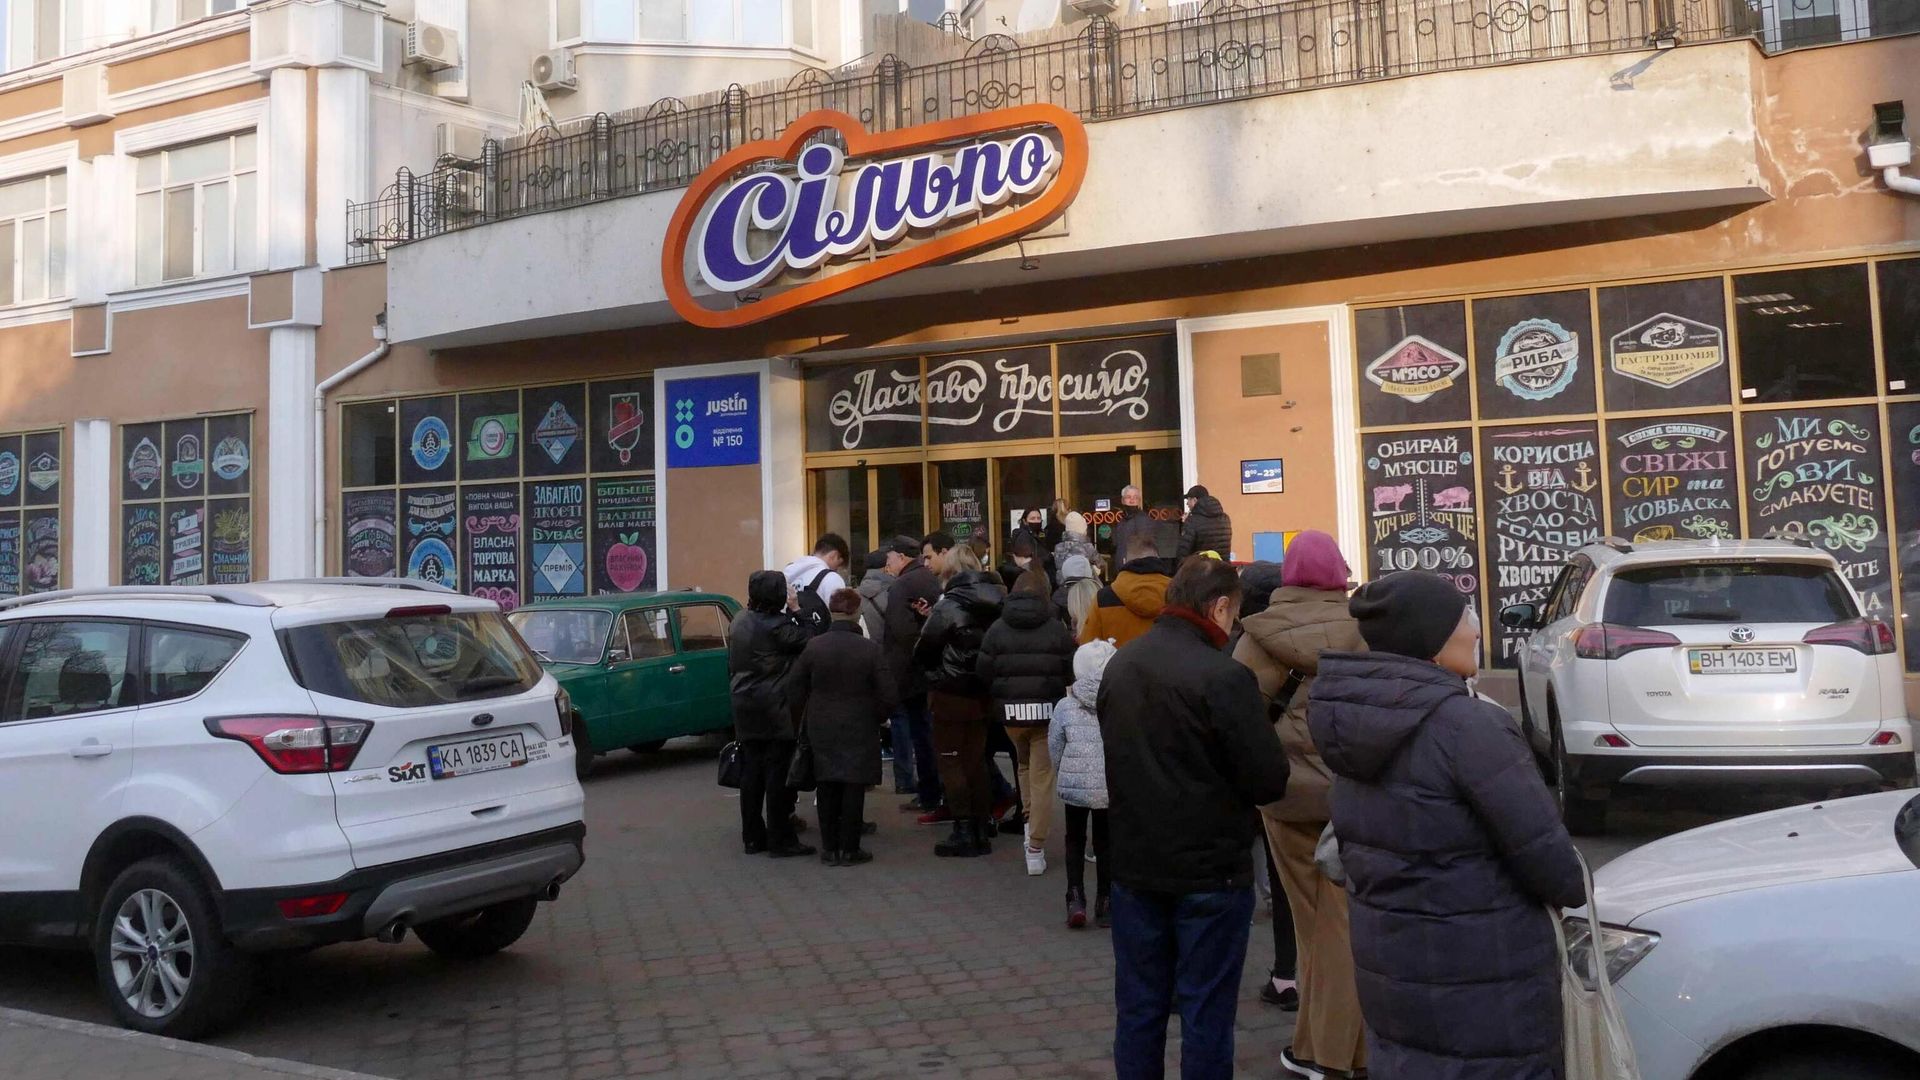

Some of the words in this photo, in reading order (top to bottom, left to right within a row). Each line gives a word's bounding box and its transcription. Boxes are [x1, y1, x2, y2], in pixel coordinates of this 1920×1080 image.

[700, 133, 1060, 291] Сільпо
[1512, 348, 1563, 369] РИБА
[1620, 350, 1714, 365] ГАСТРОНОМІЯ
[1392, 365, 1441, 382] М'ЯСО
[706, 392, 748, 416] justin
[829, 359, 987, 449] Ласкаво
[992, 350, 1149, 433] просимо
[726, 434, 743, 447] 150
[1628, 427, 1662, 444] СВІЖА
[1665, 426, 1718, 440] СМАКОТА
[1774, 416, 1822, 444] МИ
[1377, 436, 1458, 459] ОБИРАЙ
[1493, 440, 1595, 465] КОРИСНА
[1384, 460, 1458, 478] М'ЯСЦЕ
[1620, 451, 1729, 475] СВІЖІ
[1757, 439, 1867, 481] ГОТУЄМО
[1795, 459, 1856, 483] ВИ
[1527, 468, 1568, 489] ВІД
[1622, 476, 1680, 498] СИР
[533, 485, 582, 505] ЗАБАГАТО
[1496, 490, 1598, 521] ХВОСТА
[1759, 483, 1875, 517] СМАКУЄТЕ!
[468, 503, 493, 511] ВИГОДА
[494, 502, 514, 510] ВАША
[532, 505, 583, 519] ЯКОСТІ
[1623, 497, 1731, 528] КОВБАСКА
[1374, 513, 1397, 544] ХОЧ
[1401, 513, 1417, 525] ЦЕ
[1428, 513, 1454, 524] ХОЧ
[1457, 513, 1476, 541] ЦЕ
[1532, 513, 1564, 527] ДО
[473, 536, 515, 549] ВЛАСНА
[533, 527, 583, 541] БУВАЄ
[1496, 518, 1599, 547] ГОЛОВИ
[473, 551, 515, 566] ТОРГОВА
[1378, 546, 1474, 571] 100%
[1497, 533, 1574, 563] РИБК
[473, 569, 516, 582] МАРКА
[544, 563, 573, 572] ПРЕМІЯ
[1499, 586, 1552, 612] МАХ
[1701, 653, 1725, 667] BH
[1729, 652, 1764, 667] 1403
[1768, 652, 1792, 666] EM
[1004, 702, 1053, 720] PUMA
[440, 748, 463, 769] KA
[466, 743, 497, 765] 1839
[500, 739, 520, 758] CA
